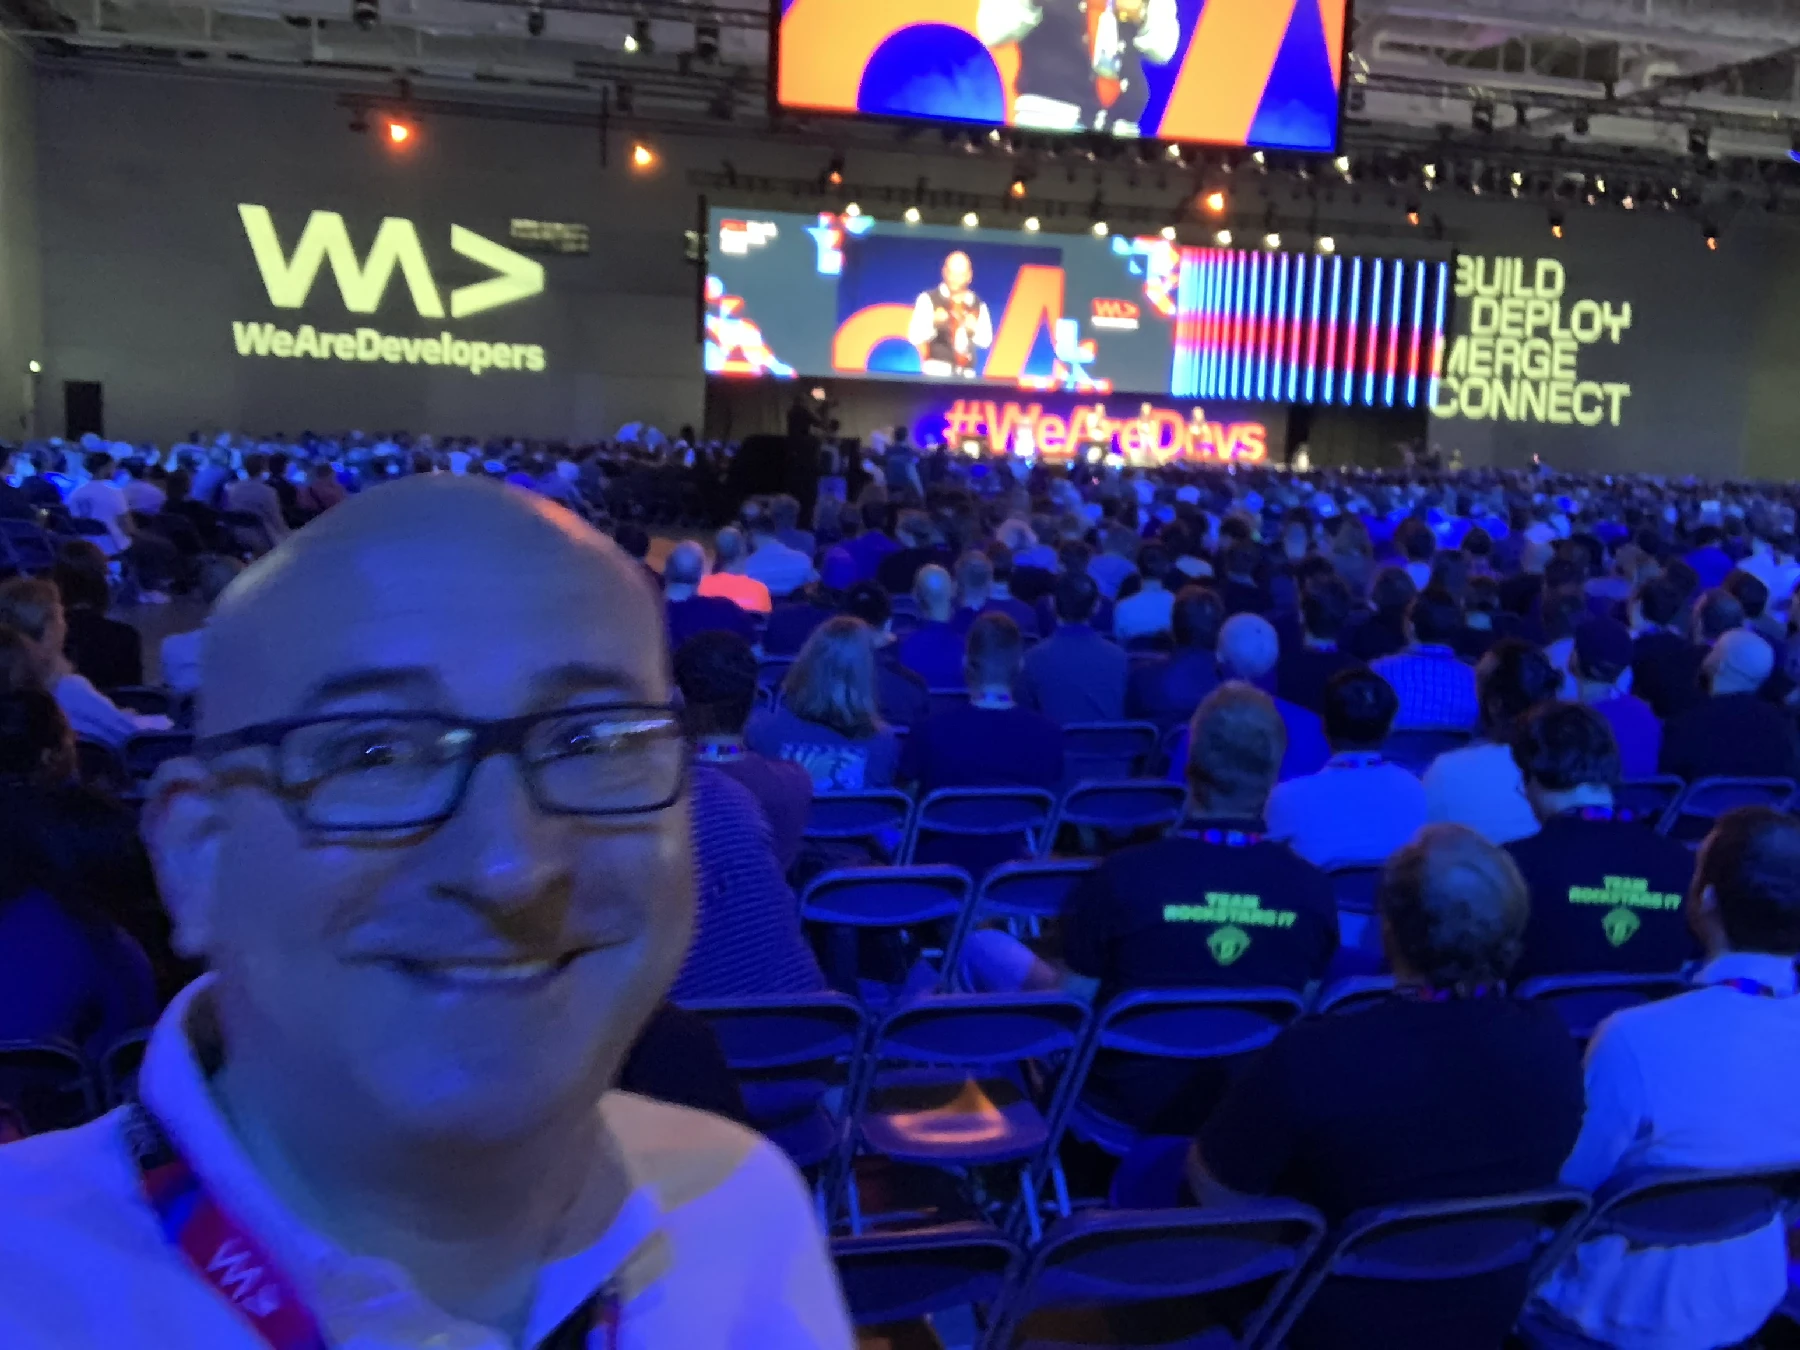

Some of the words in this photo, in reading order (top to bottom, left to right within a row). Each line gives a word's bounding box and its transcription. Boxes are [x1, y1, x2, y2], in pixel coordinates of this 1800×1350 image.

[1454, 254, 1565, 300] BUILD
[1471, 296, 1632, 344] DEPLOY
[232, 321, 546, 375] WeAreDevelopers
[1429, 377, 1632, 427] CONNECT
